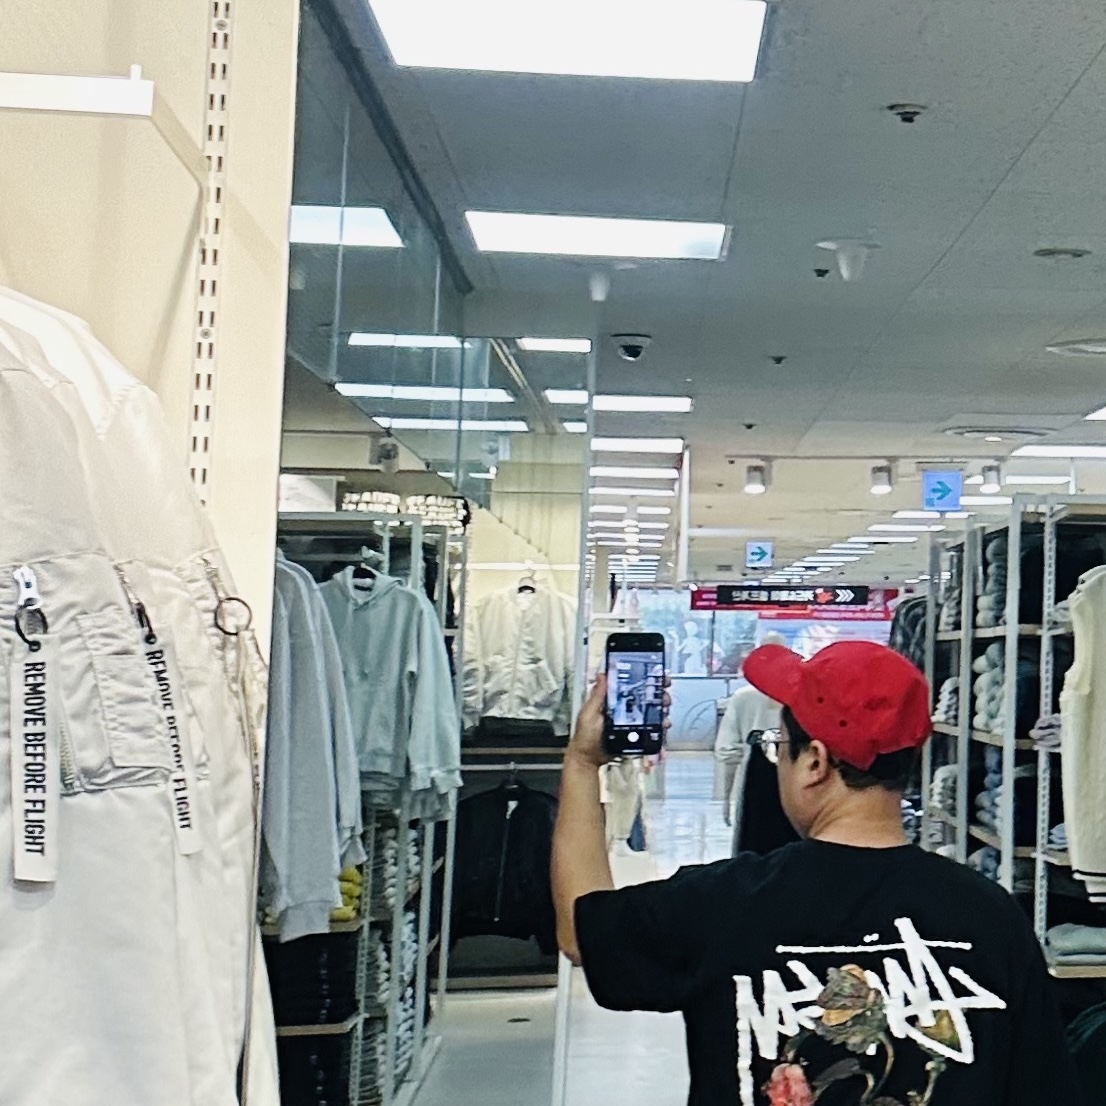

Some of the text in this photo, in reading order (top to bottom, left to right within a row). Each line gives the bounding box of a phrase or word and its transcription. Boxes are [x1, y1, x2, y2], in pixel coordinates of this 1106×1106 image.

[23, 661, 47, 857] REMOVE BEFORE FLIGHT
